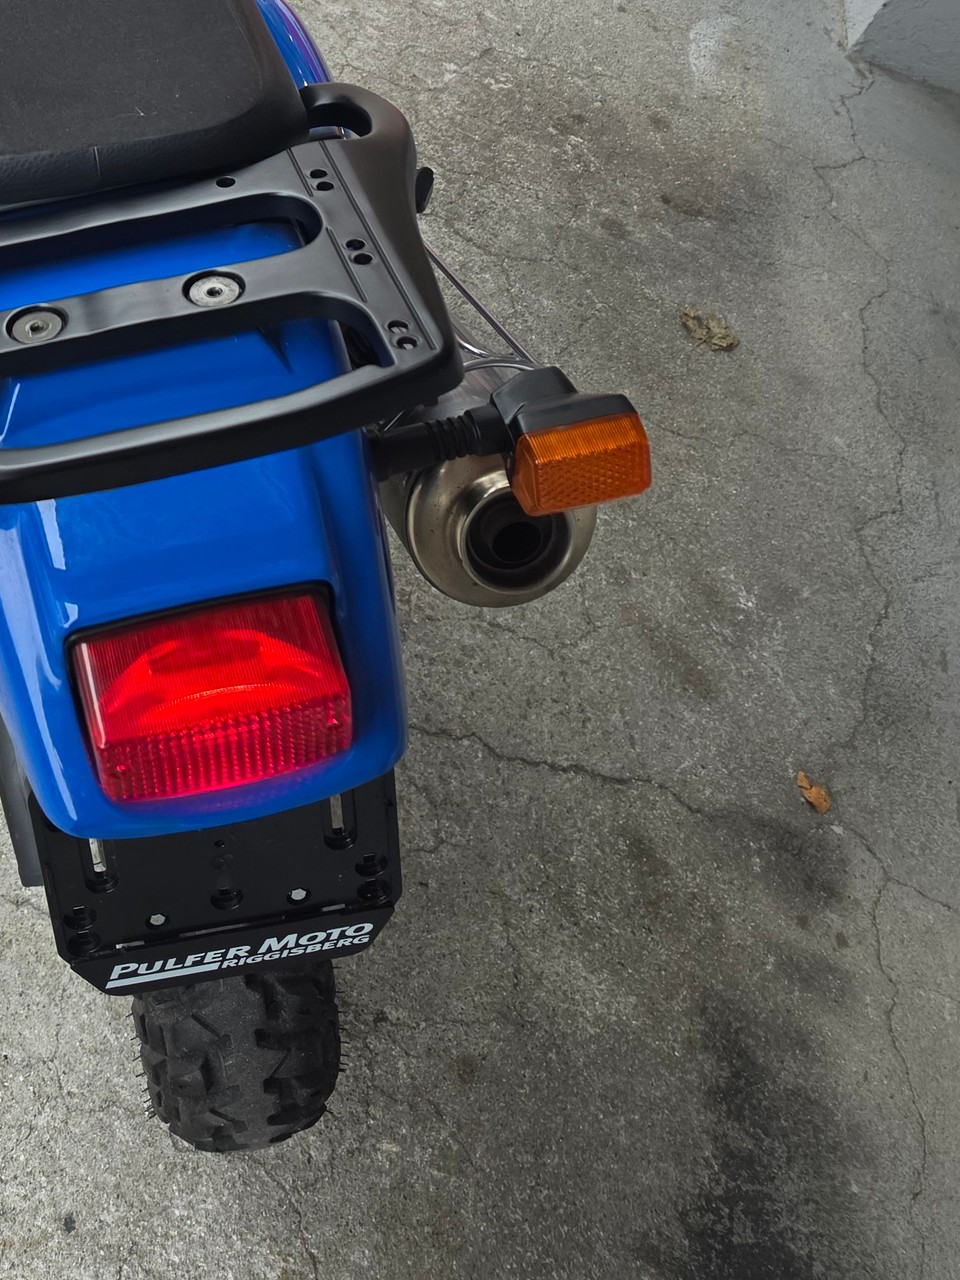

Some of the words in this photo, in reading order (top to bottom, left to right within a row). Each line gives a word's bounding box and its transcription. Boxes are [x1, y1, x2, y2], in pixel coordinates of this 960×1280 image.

[109, 945, 252, 980] PULFER
[257, 923, 375, 953] MOTO
[221, 935, 371, 970] RIGGISBERG
